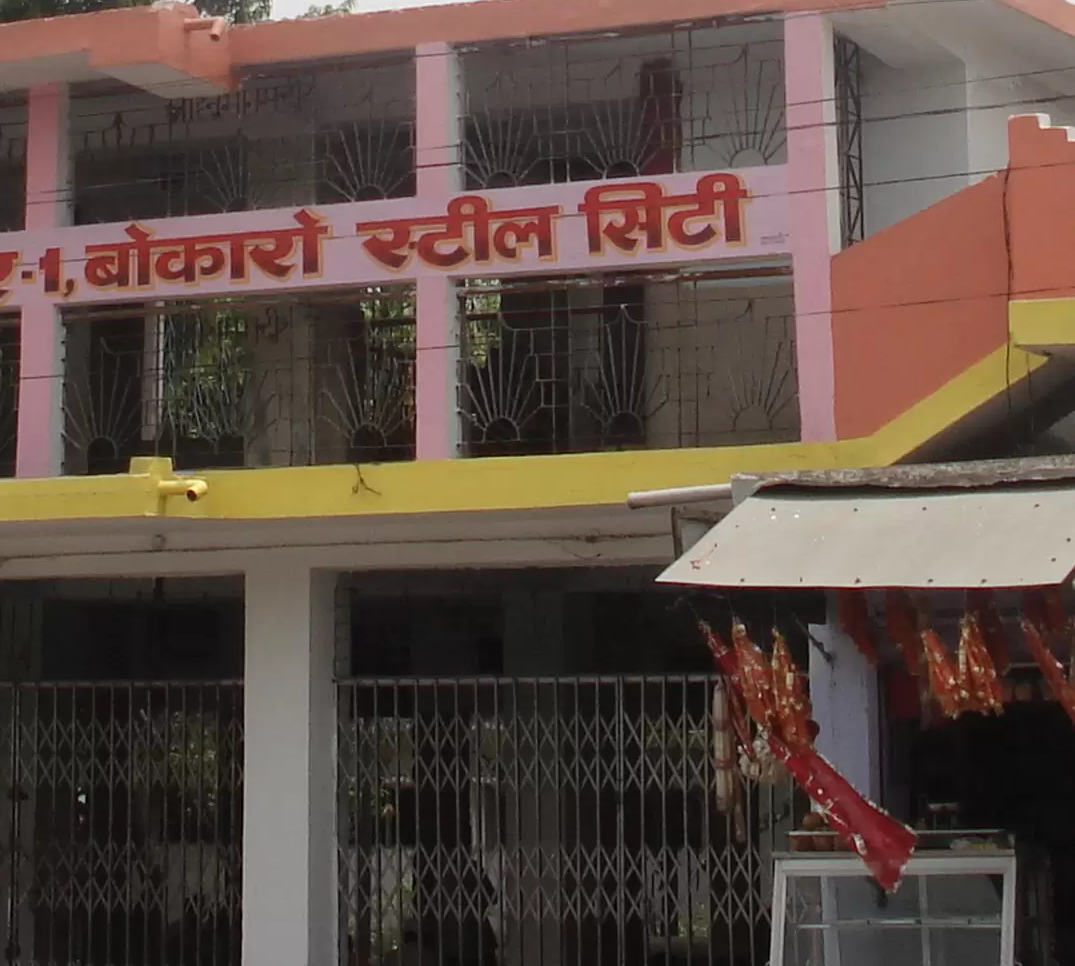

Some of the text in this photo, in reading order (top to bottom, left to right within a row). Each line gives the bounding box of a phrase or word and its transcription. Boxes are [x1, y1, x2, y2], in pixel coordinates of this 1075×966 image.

[85, 209, 328, 288] बोकारो
[356, 196, 561, 268] स्टील
[579, 173, 749, 255] सिटी
